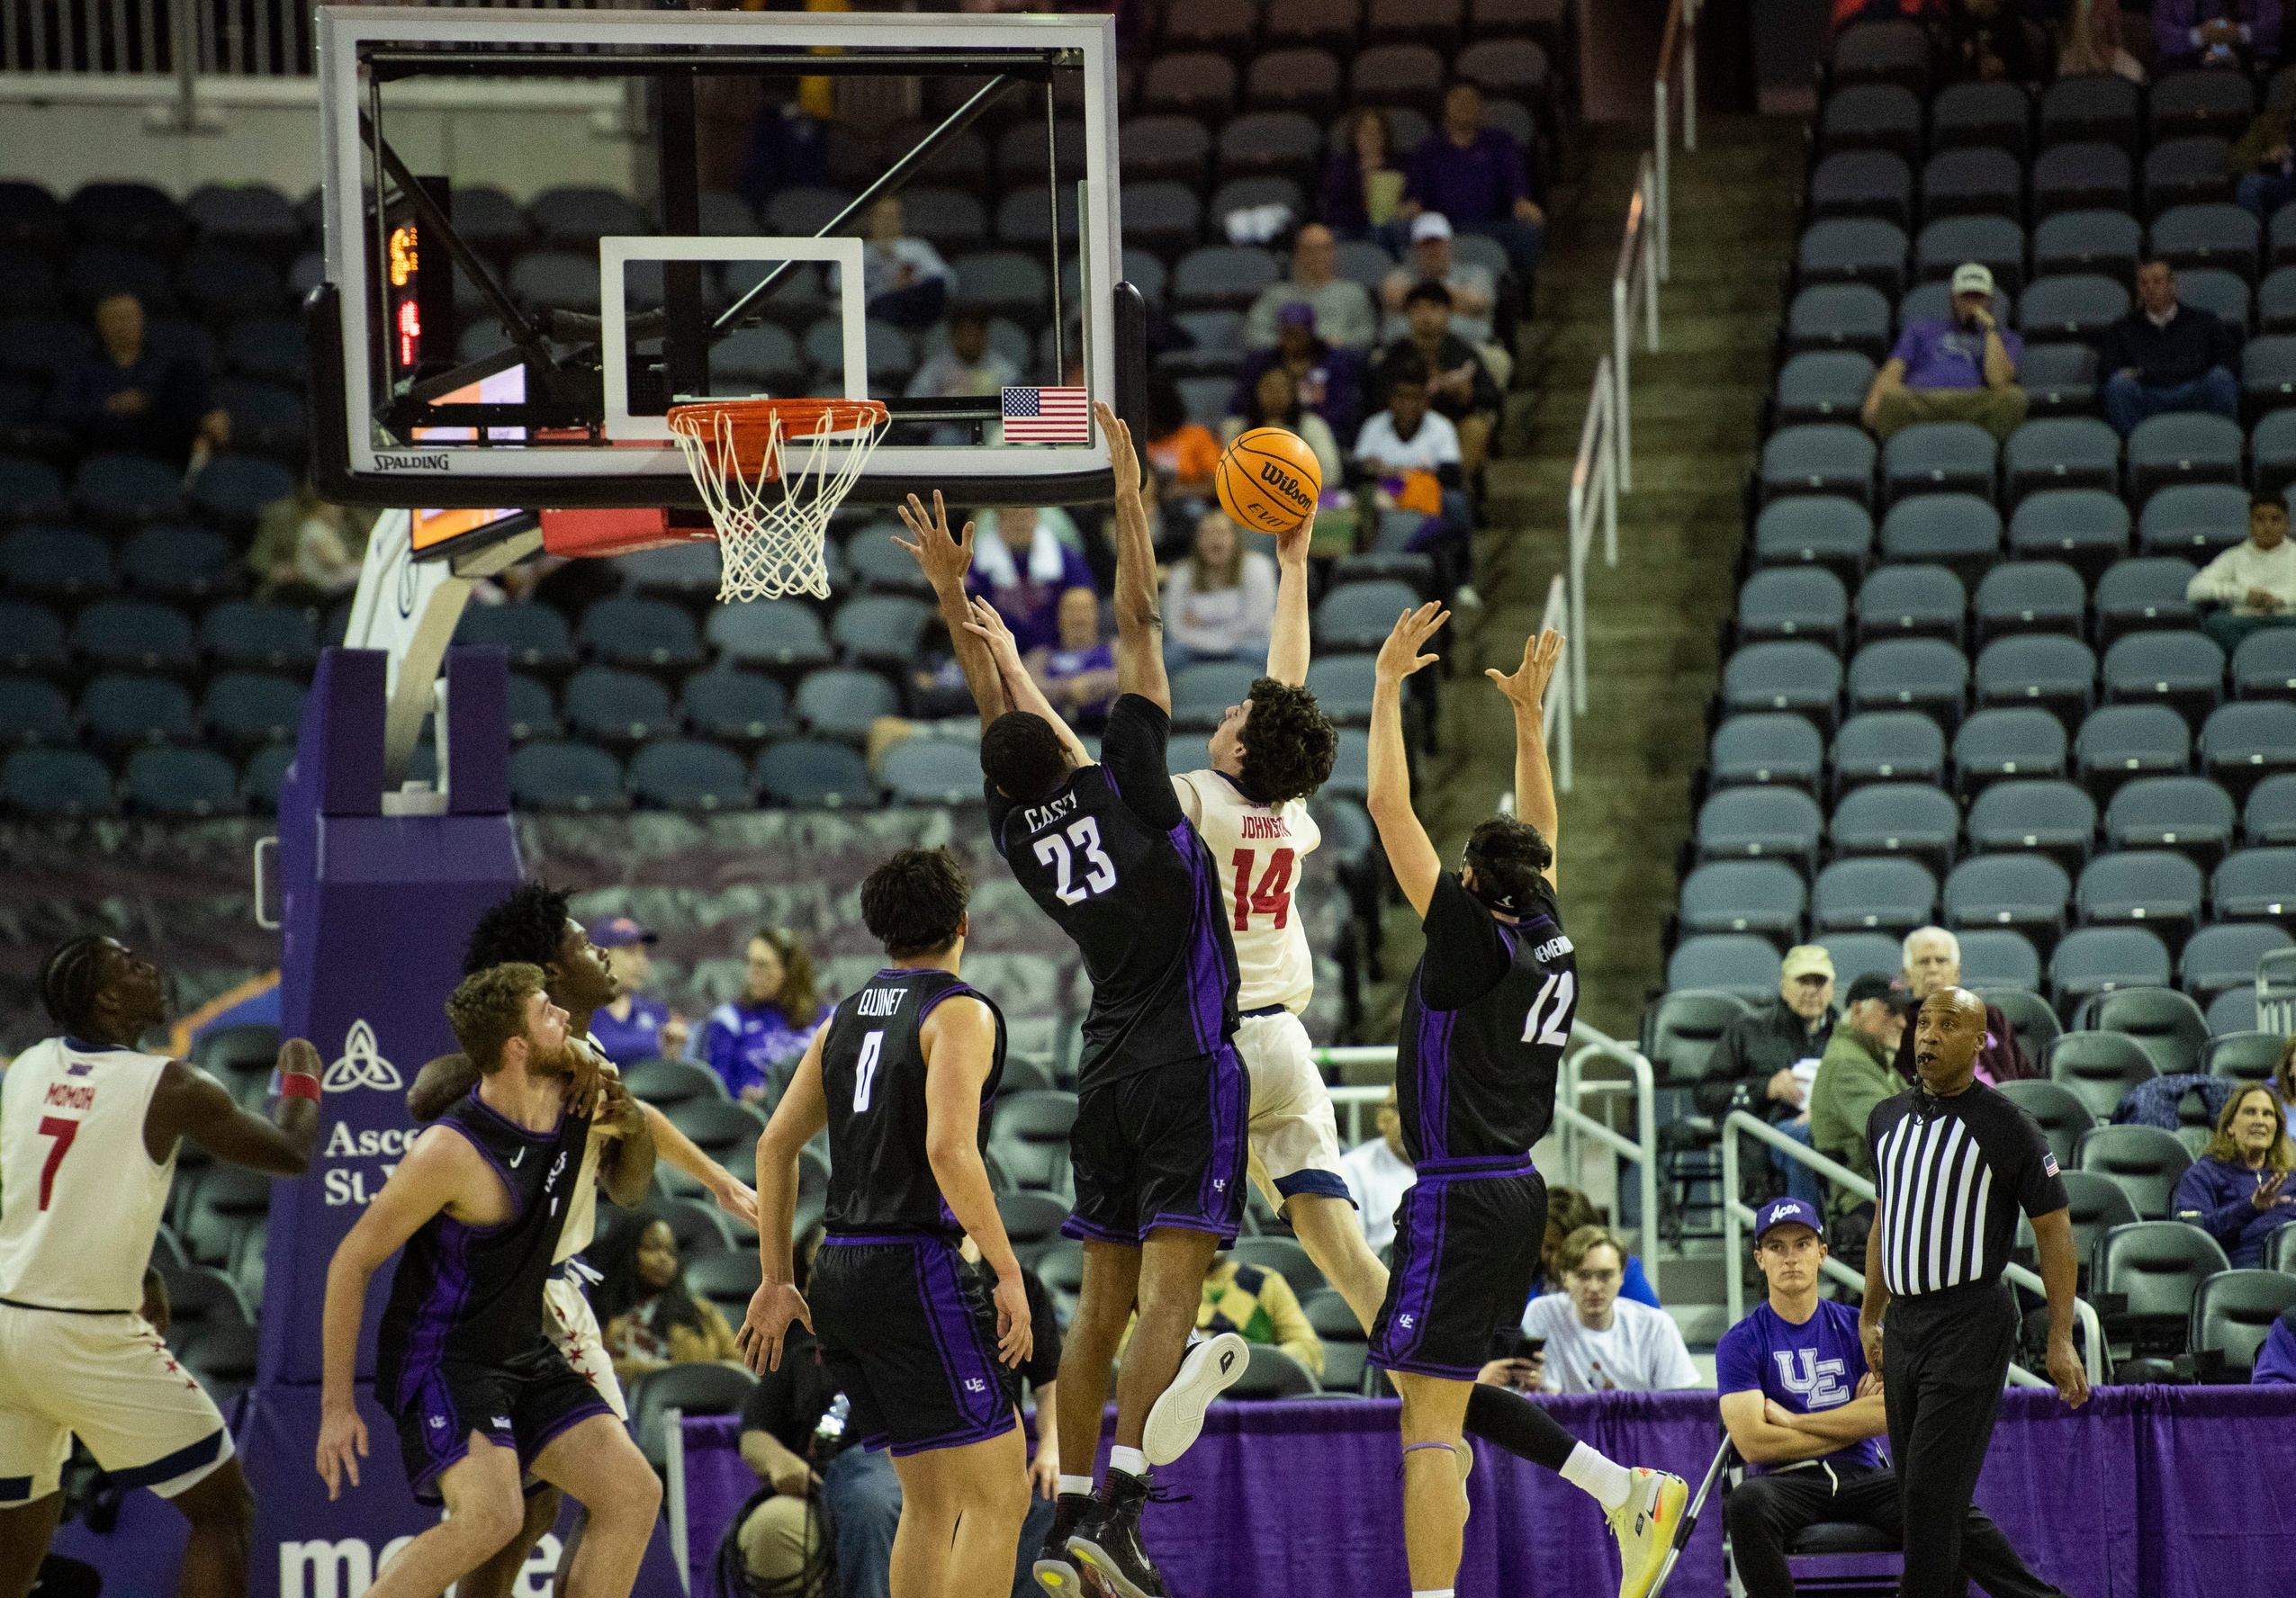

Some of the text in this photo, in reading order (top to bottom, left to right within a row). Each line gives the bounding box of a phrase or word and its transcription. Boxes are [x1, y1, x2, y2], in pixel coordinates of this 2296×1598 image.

[374, 453, 449, 471] SPALDING
[1260, 461, 1313, 512] Wilson
[1032, 815, 1117, 906] 23
[1231, 848, 1295, 931] 14
[857, 989, 908, 1016] QUINET
[1520, 970, 1574, 1046] 12
[853, 1030, 884, 1112] 0
[38, 1115, 80, 1212] 7
[1769, 1204, 1801, 1224] Aces
[1399, 1314, 1414, 1329] UE
[964, 1378, 986, 1393] UE
[1773, 1348, 1850, 1409] UE
